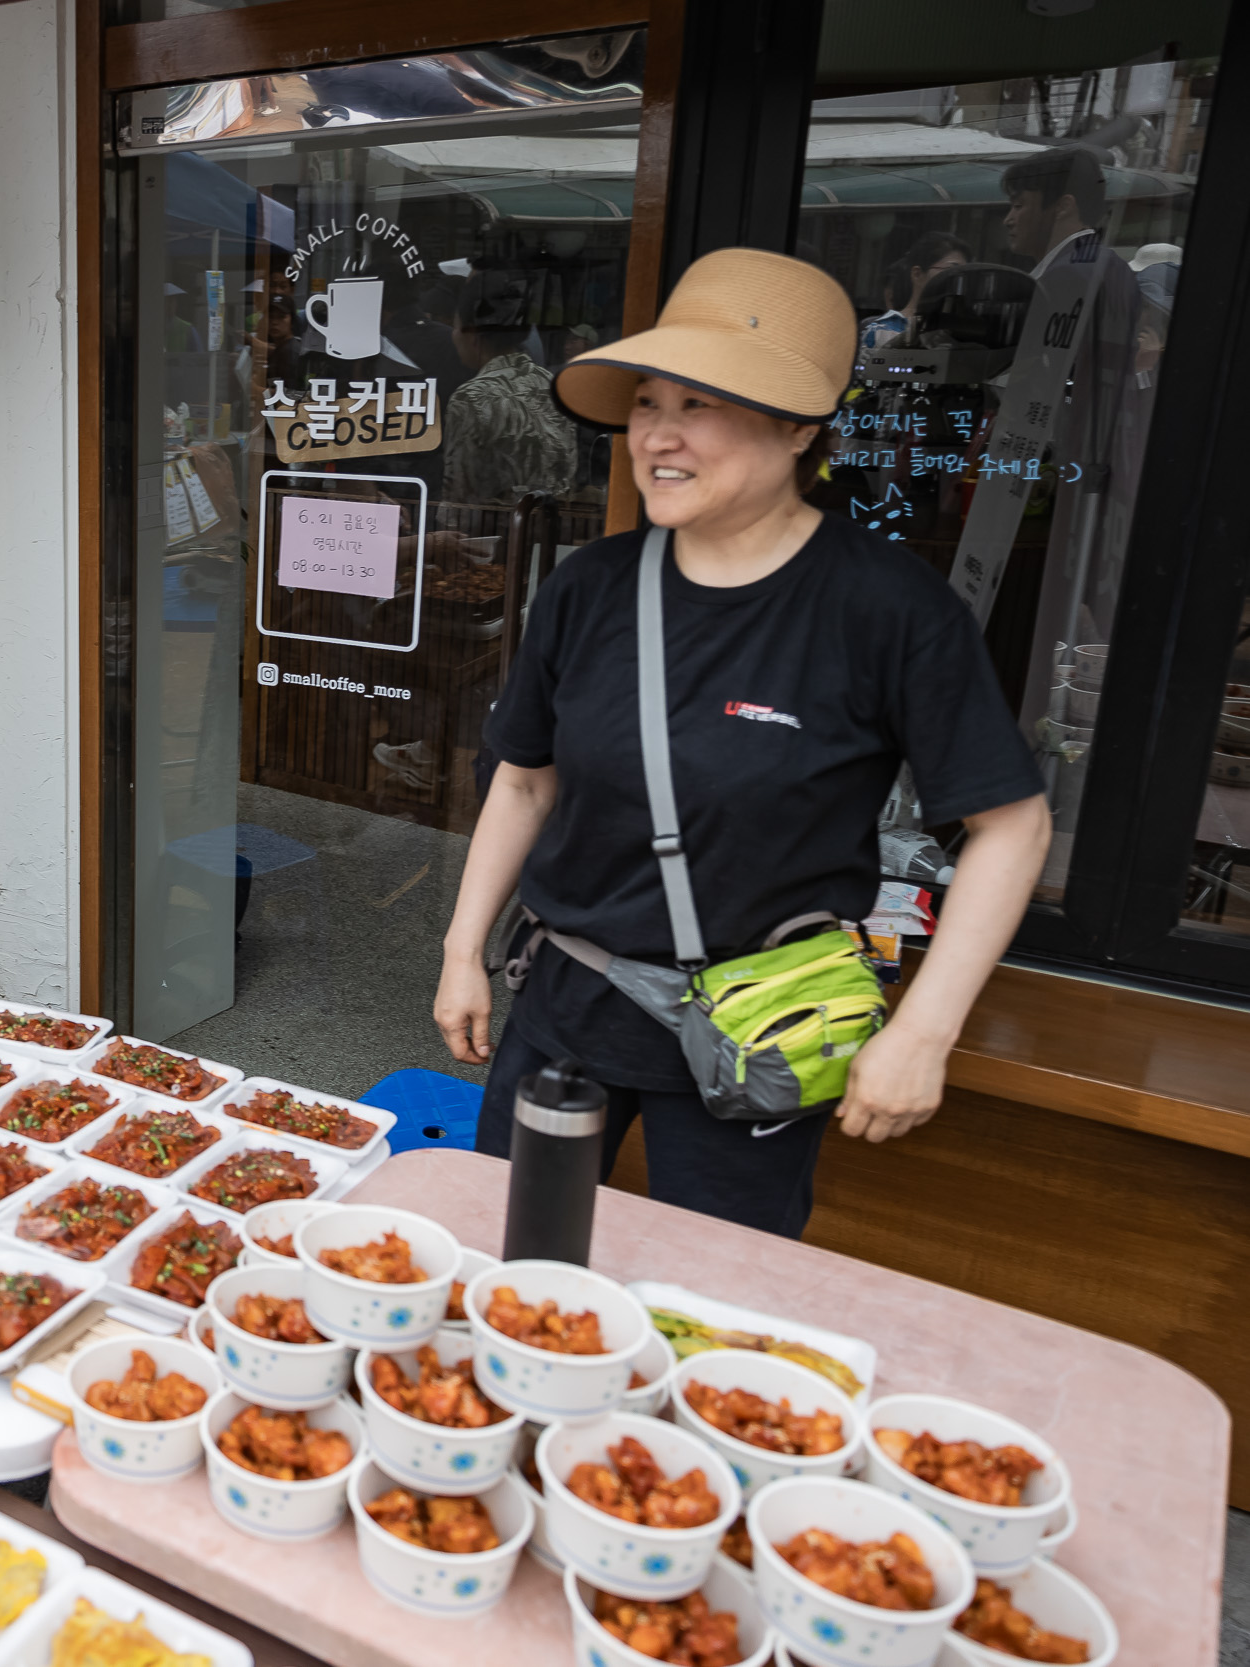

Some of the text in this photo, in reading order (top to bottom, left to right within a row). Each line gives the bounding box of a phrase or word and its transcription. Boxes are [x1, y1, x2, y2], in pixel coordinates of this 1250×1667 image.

[285, 213, 425, 282] SMALL COFFEE
[260, 377, 437, 440] 스몰커피
[977, 453, 1041, 481] 주세요
[343, 513, 380, 535] 금요일
[282, 673, 412, 700] smallcoffee_more
